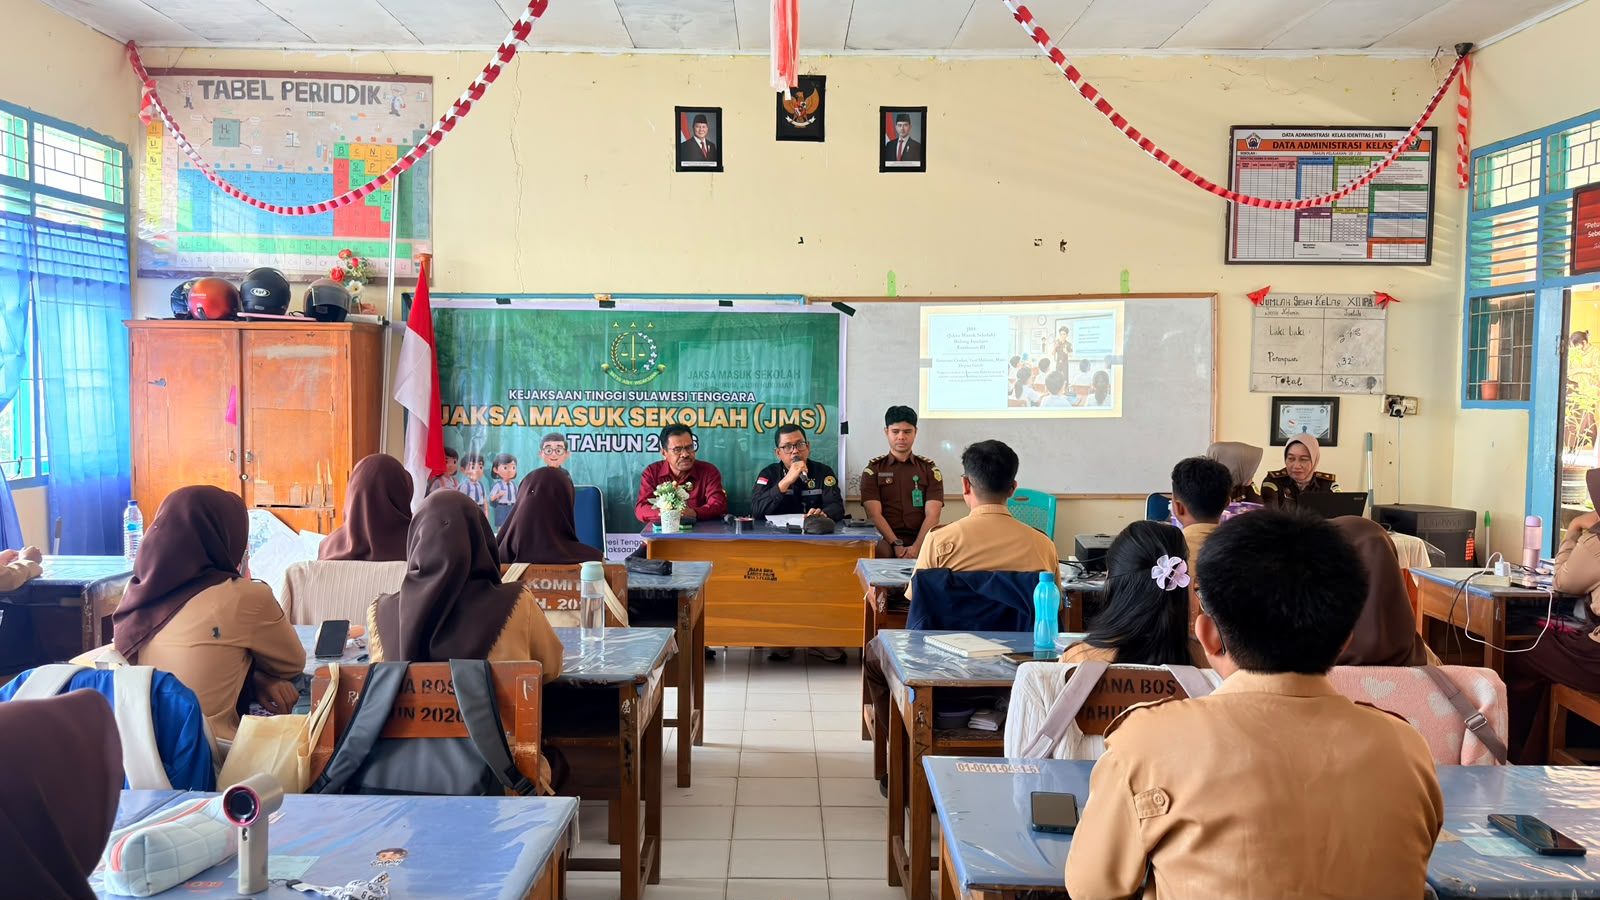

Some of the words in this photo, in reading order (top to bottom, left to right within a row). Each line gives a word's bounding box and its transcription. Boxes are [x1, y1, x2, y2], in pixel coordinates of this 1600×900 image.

[197, 80, 274, 100] TABEL
[281, 81, 382, 105] PERIODIK
[1272, 141, 1296, 149] DATA
[1297, 141, 1362, 149] ADMINISTRASI
[1365, 141, 1393, 149] KELAS
[688, 370, 717, 380] JAKSA
[719, 370, 752, 380] MASUK
[755, 369, 801, 380] SEKOLAH
[1271, 375, 1303, 386] Total
[508, 390, 582, 400] KEJAKSAAN
[585, 391, 626, 401] TINGGI
[628, 391, 688, 401] SULAWESI
[691, 392, 756, 402] TENGGARA
[442, 405, 526, 426] JAKSA
[529, 406, 626, 427] MASUK
[629, 407, 749, 428] SEKOLAH
[753, 402, 827, 434] (JMS)
[566, 434, 645, 453] TAHUN
[529, 578, 582, 591] KOMIT
[1099, 678, 1135, 694] ANA
[1141, 679, 1177, 695] BOS
